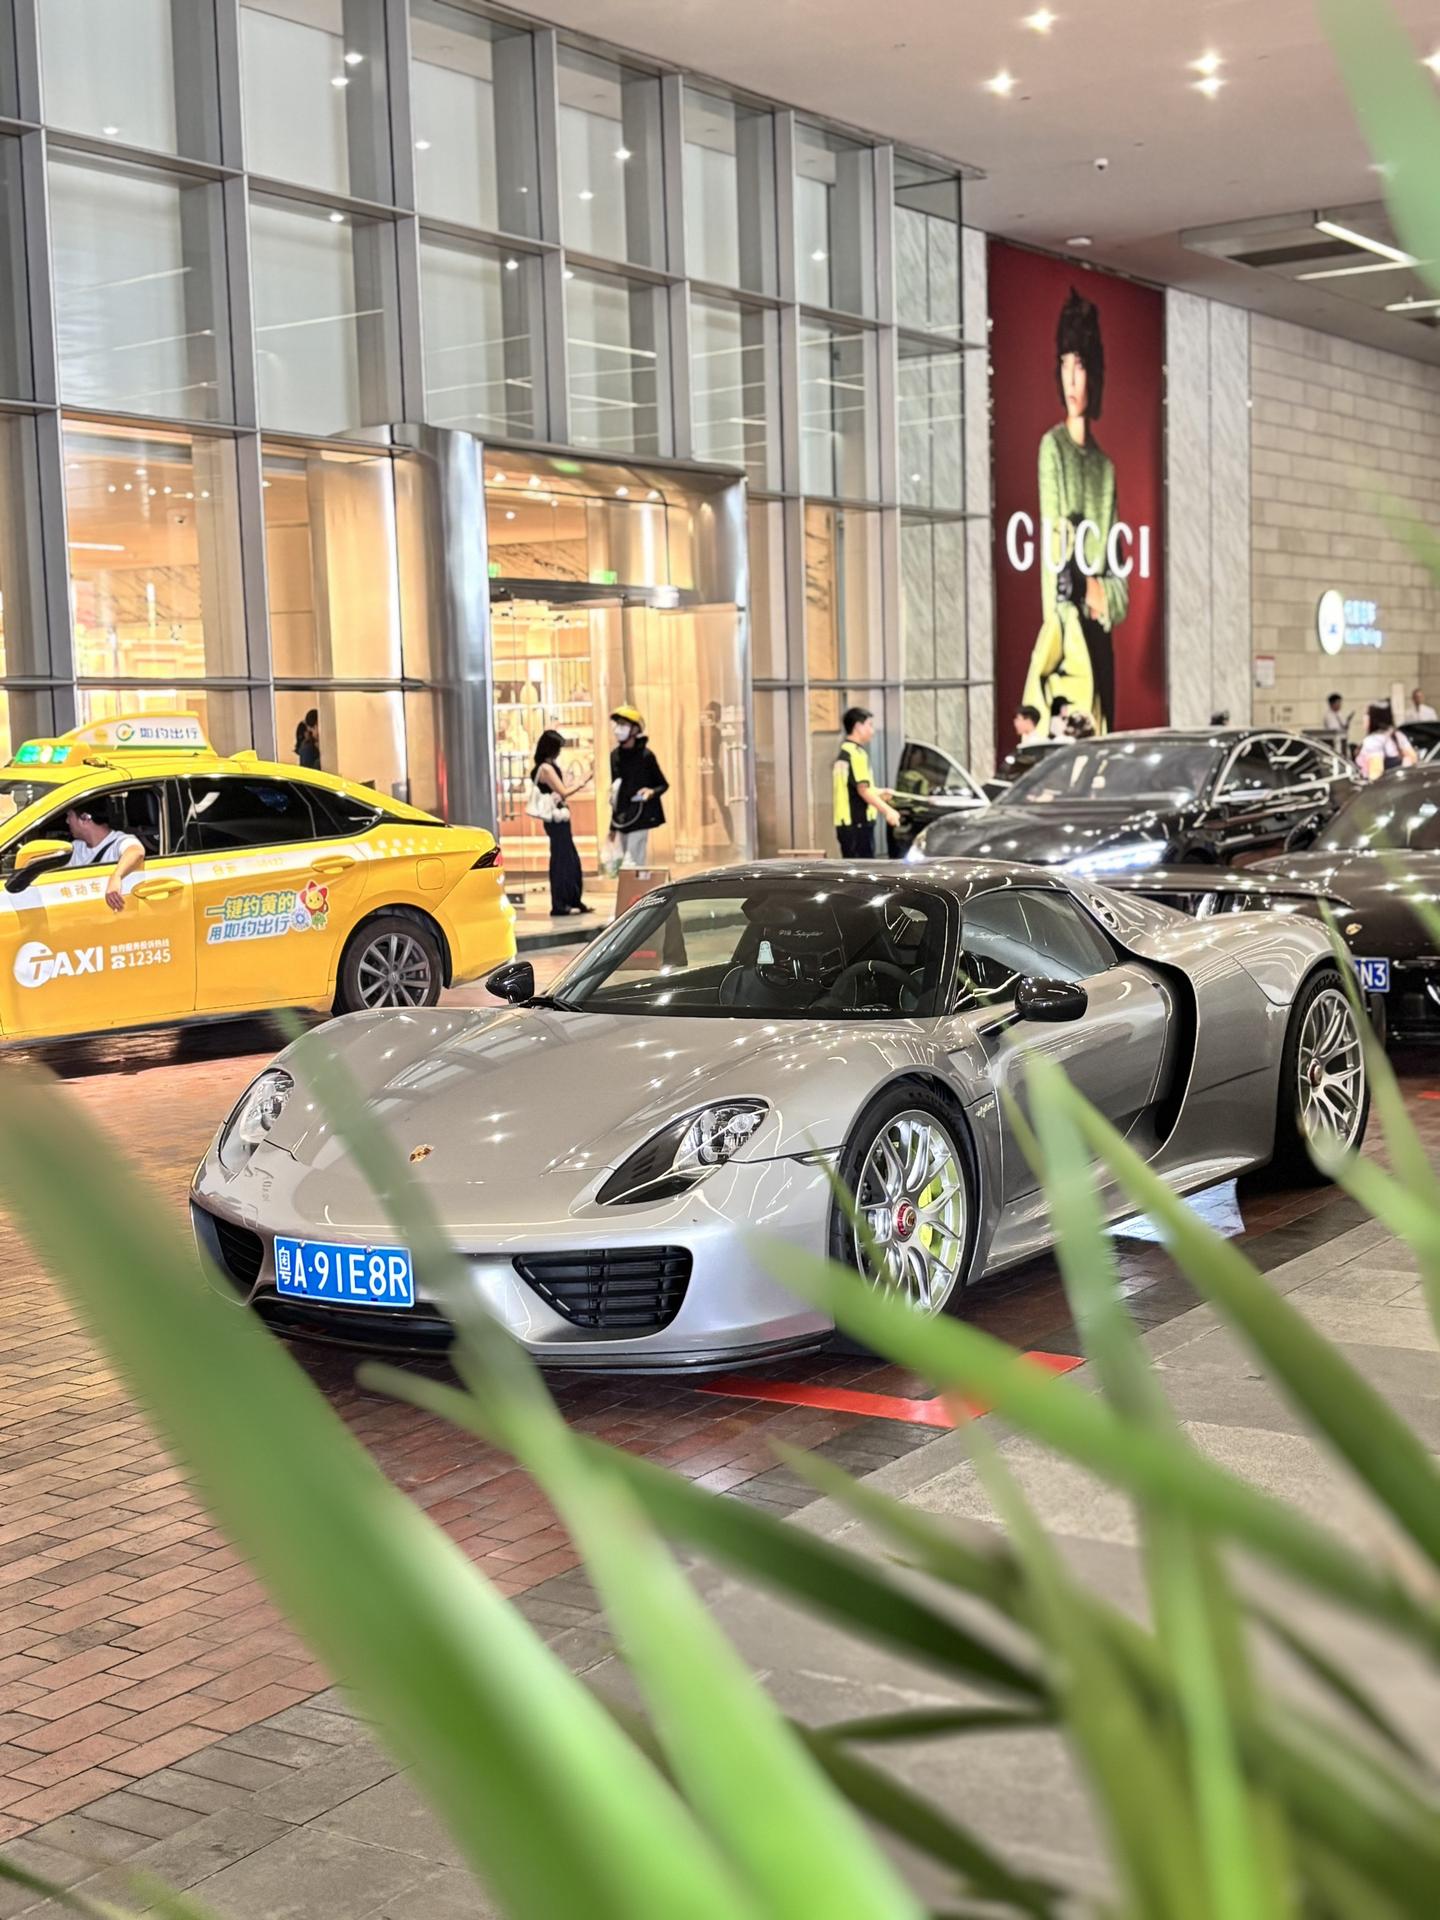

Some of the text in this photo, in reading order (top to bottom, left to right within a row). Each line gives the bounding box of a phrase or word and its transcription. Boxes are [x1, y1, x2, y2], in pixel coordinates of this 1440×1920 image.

[1006, 511, 1150, 579] GUCCI
[139, 727, 199, 739] 如约出行
[206, 891, 297, 920] 一键约黄的
[208, 916, 291, 941] 用如约出行
[20, 944, 105, 984] TAXI
[128, 948, 171, 967] 12345
